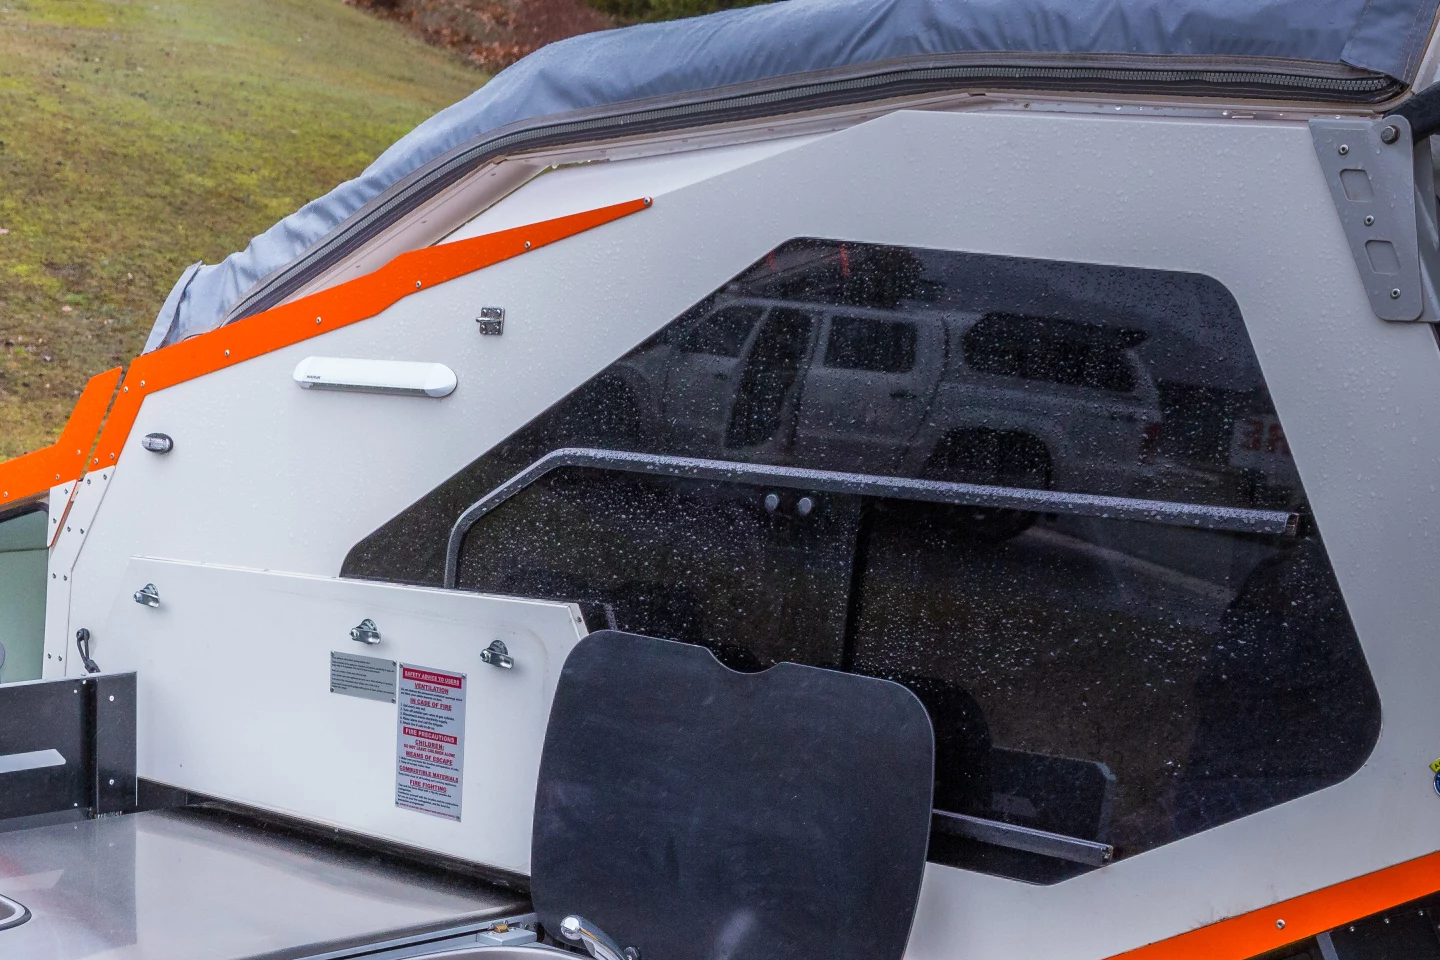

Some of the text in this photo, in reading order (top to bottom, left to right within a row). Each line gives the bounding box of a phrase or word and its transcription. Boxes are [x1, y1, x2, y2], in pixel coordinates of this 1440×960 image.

[404, 670, 422, 679] SAFETY
[421, 673, 438, 682] ADVICE
[444, 678, 460, 686] USERS
[414, 682, 449, 695] VENTILATION
[416, 698, 431, 708] CASE
[440, 702, 452, 711] FIRE
[405, 727, 455, 743] FIRE PRECAUTIONS
[405, 750, 424, 759] MEANS
[432, 755, 453, 766] ESCAPE
[399, 765, 432, 777] COMBUSTIBLE
[432, 772, 459, 784] MATERIALS
[409, 779, 422, 787] FIRE
[422, 782, 447, 793] FIGHTING
